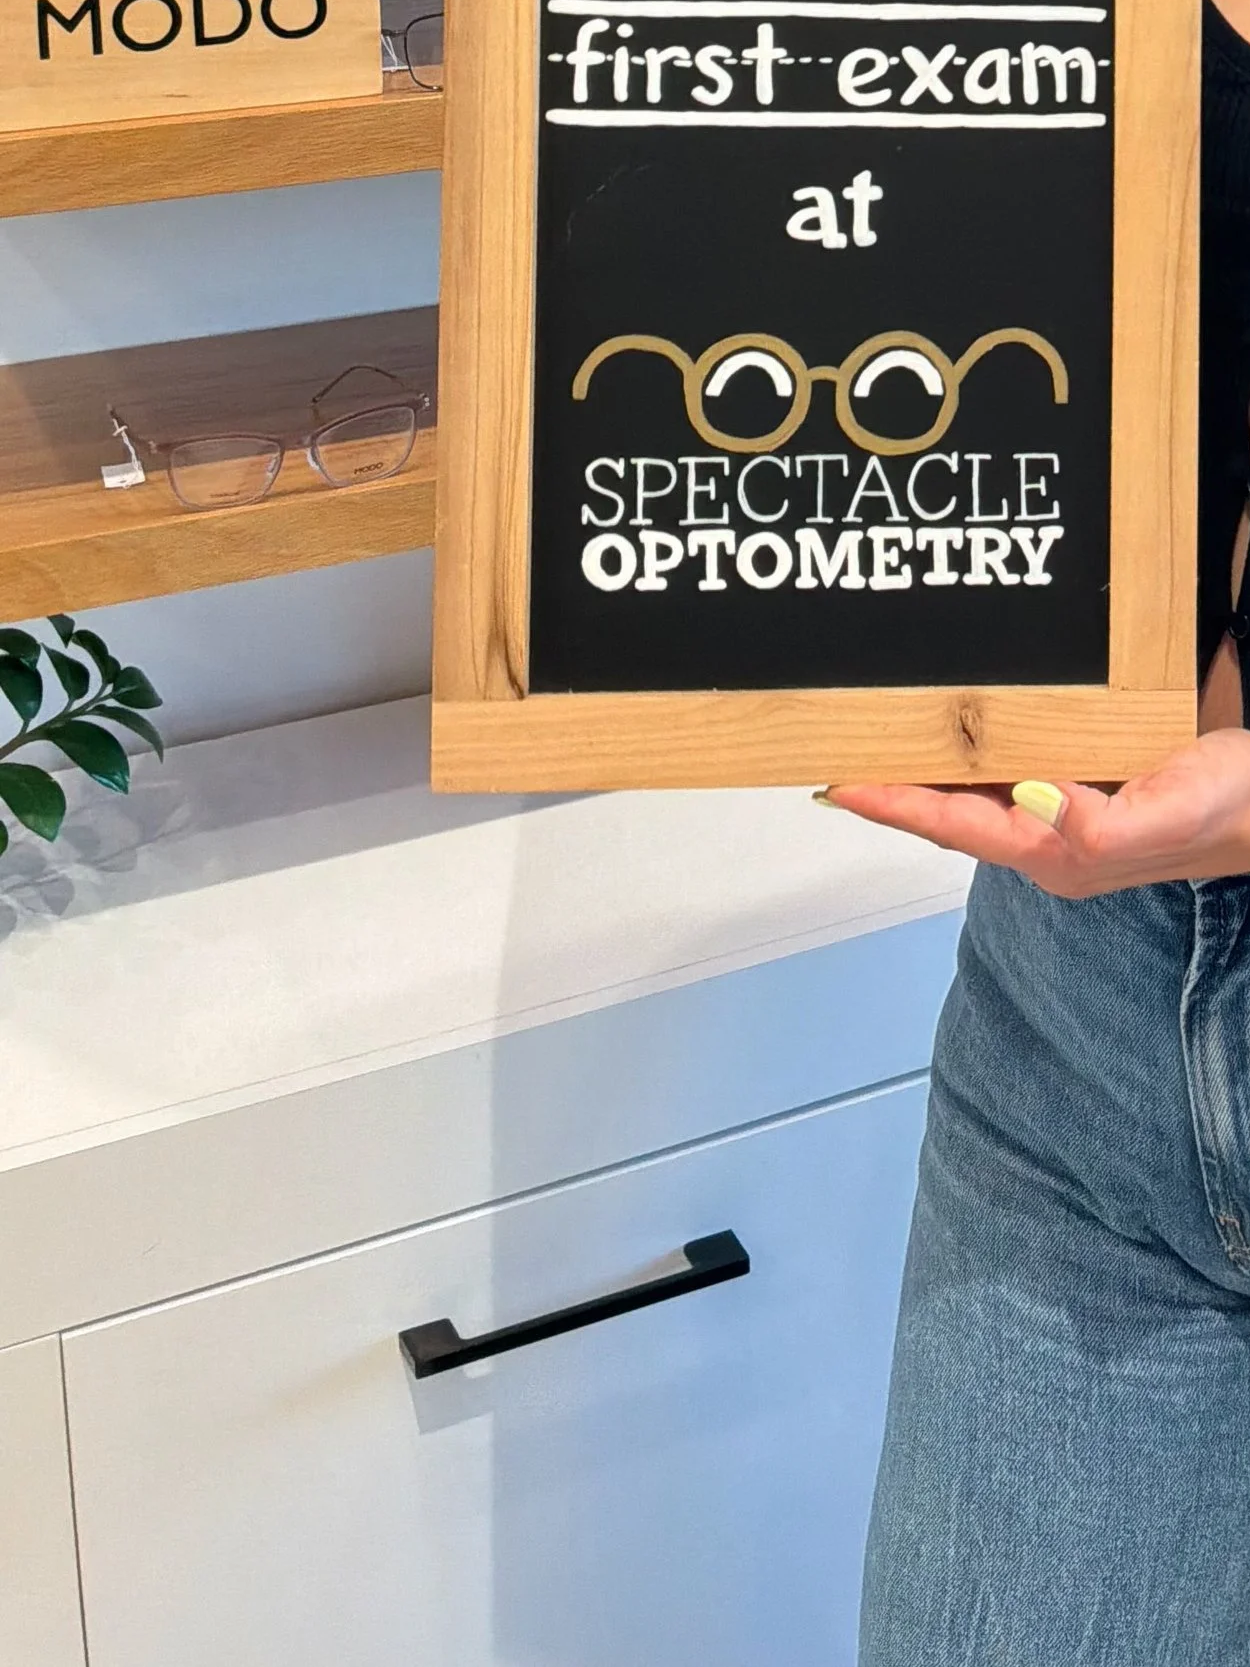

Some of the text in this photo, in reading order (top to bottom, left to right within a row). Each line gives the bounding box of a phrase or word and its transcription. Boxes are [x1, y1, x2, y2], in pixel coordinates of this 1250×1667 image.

[566, 18, 1097, 106] first exam
[786, 170, 883, 249] at
[353, 462, 384, 475] MODO
[581, 451, 1061, 527] SPECTACLE
[581, 526, 1064, 591] OPTOMETRY
